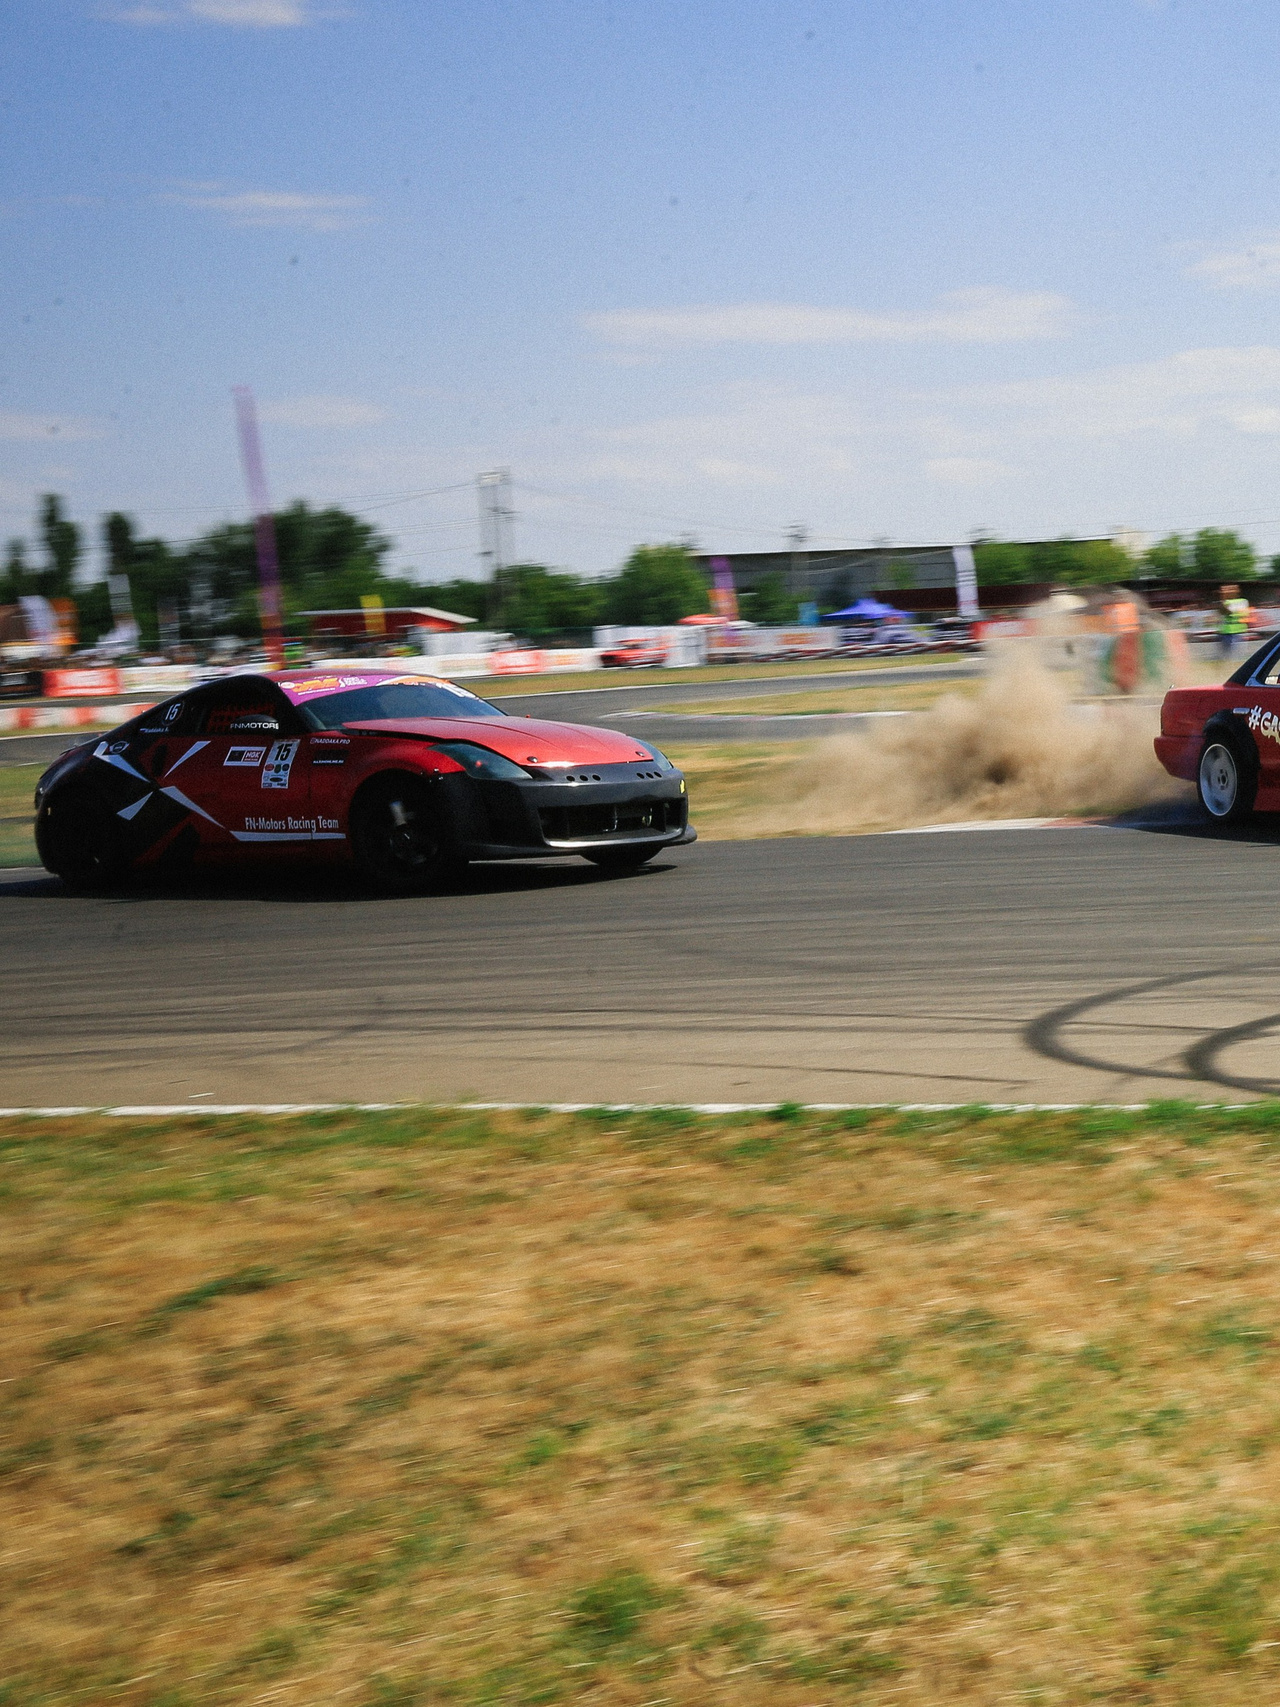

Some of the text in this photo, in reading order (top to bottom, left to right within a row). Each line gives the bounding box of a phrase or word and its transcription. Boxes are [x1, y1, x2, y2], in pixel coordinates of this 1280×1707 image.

[165, 703, 181, 720] 15
[274, 743, 293, 761] 15
[245, 815, 339, 833] FN-Motors Racing Team
